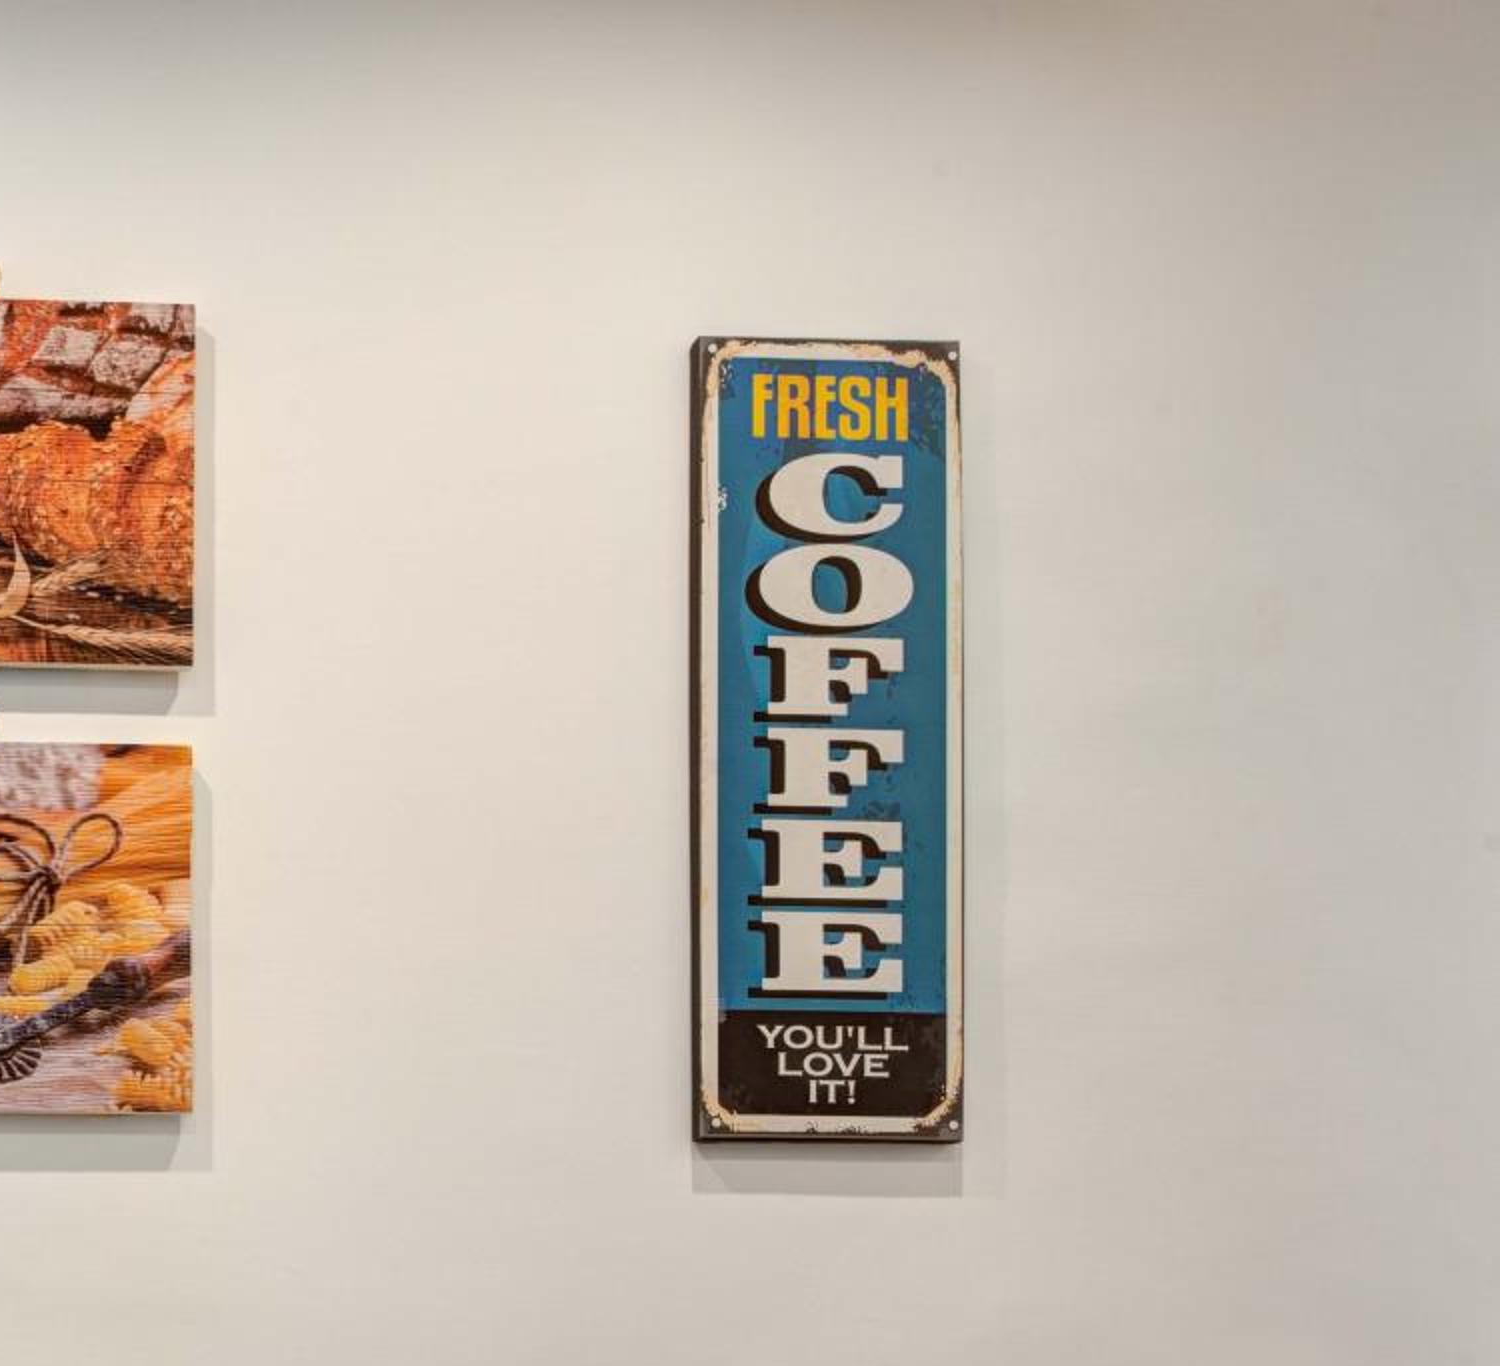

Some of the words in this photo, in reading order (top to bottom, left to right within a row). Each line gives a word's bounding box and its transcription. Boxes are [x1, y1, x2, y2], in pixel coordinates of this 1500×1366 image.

[752, 373, 909, 442] FRESH
[744, 453, 915, 1000] COFFEE
[756, 1024, 910, 1052] YOU'LL
[777, 1051, 890, 1077] LOVE
[809, 1079, 856, 1104] IT!
